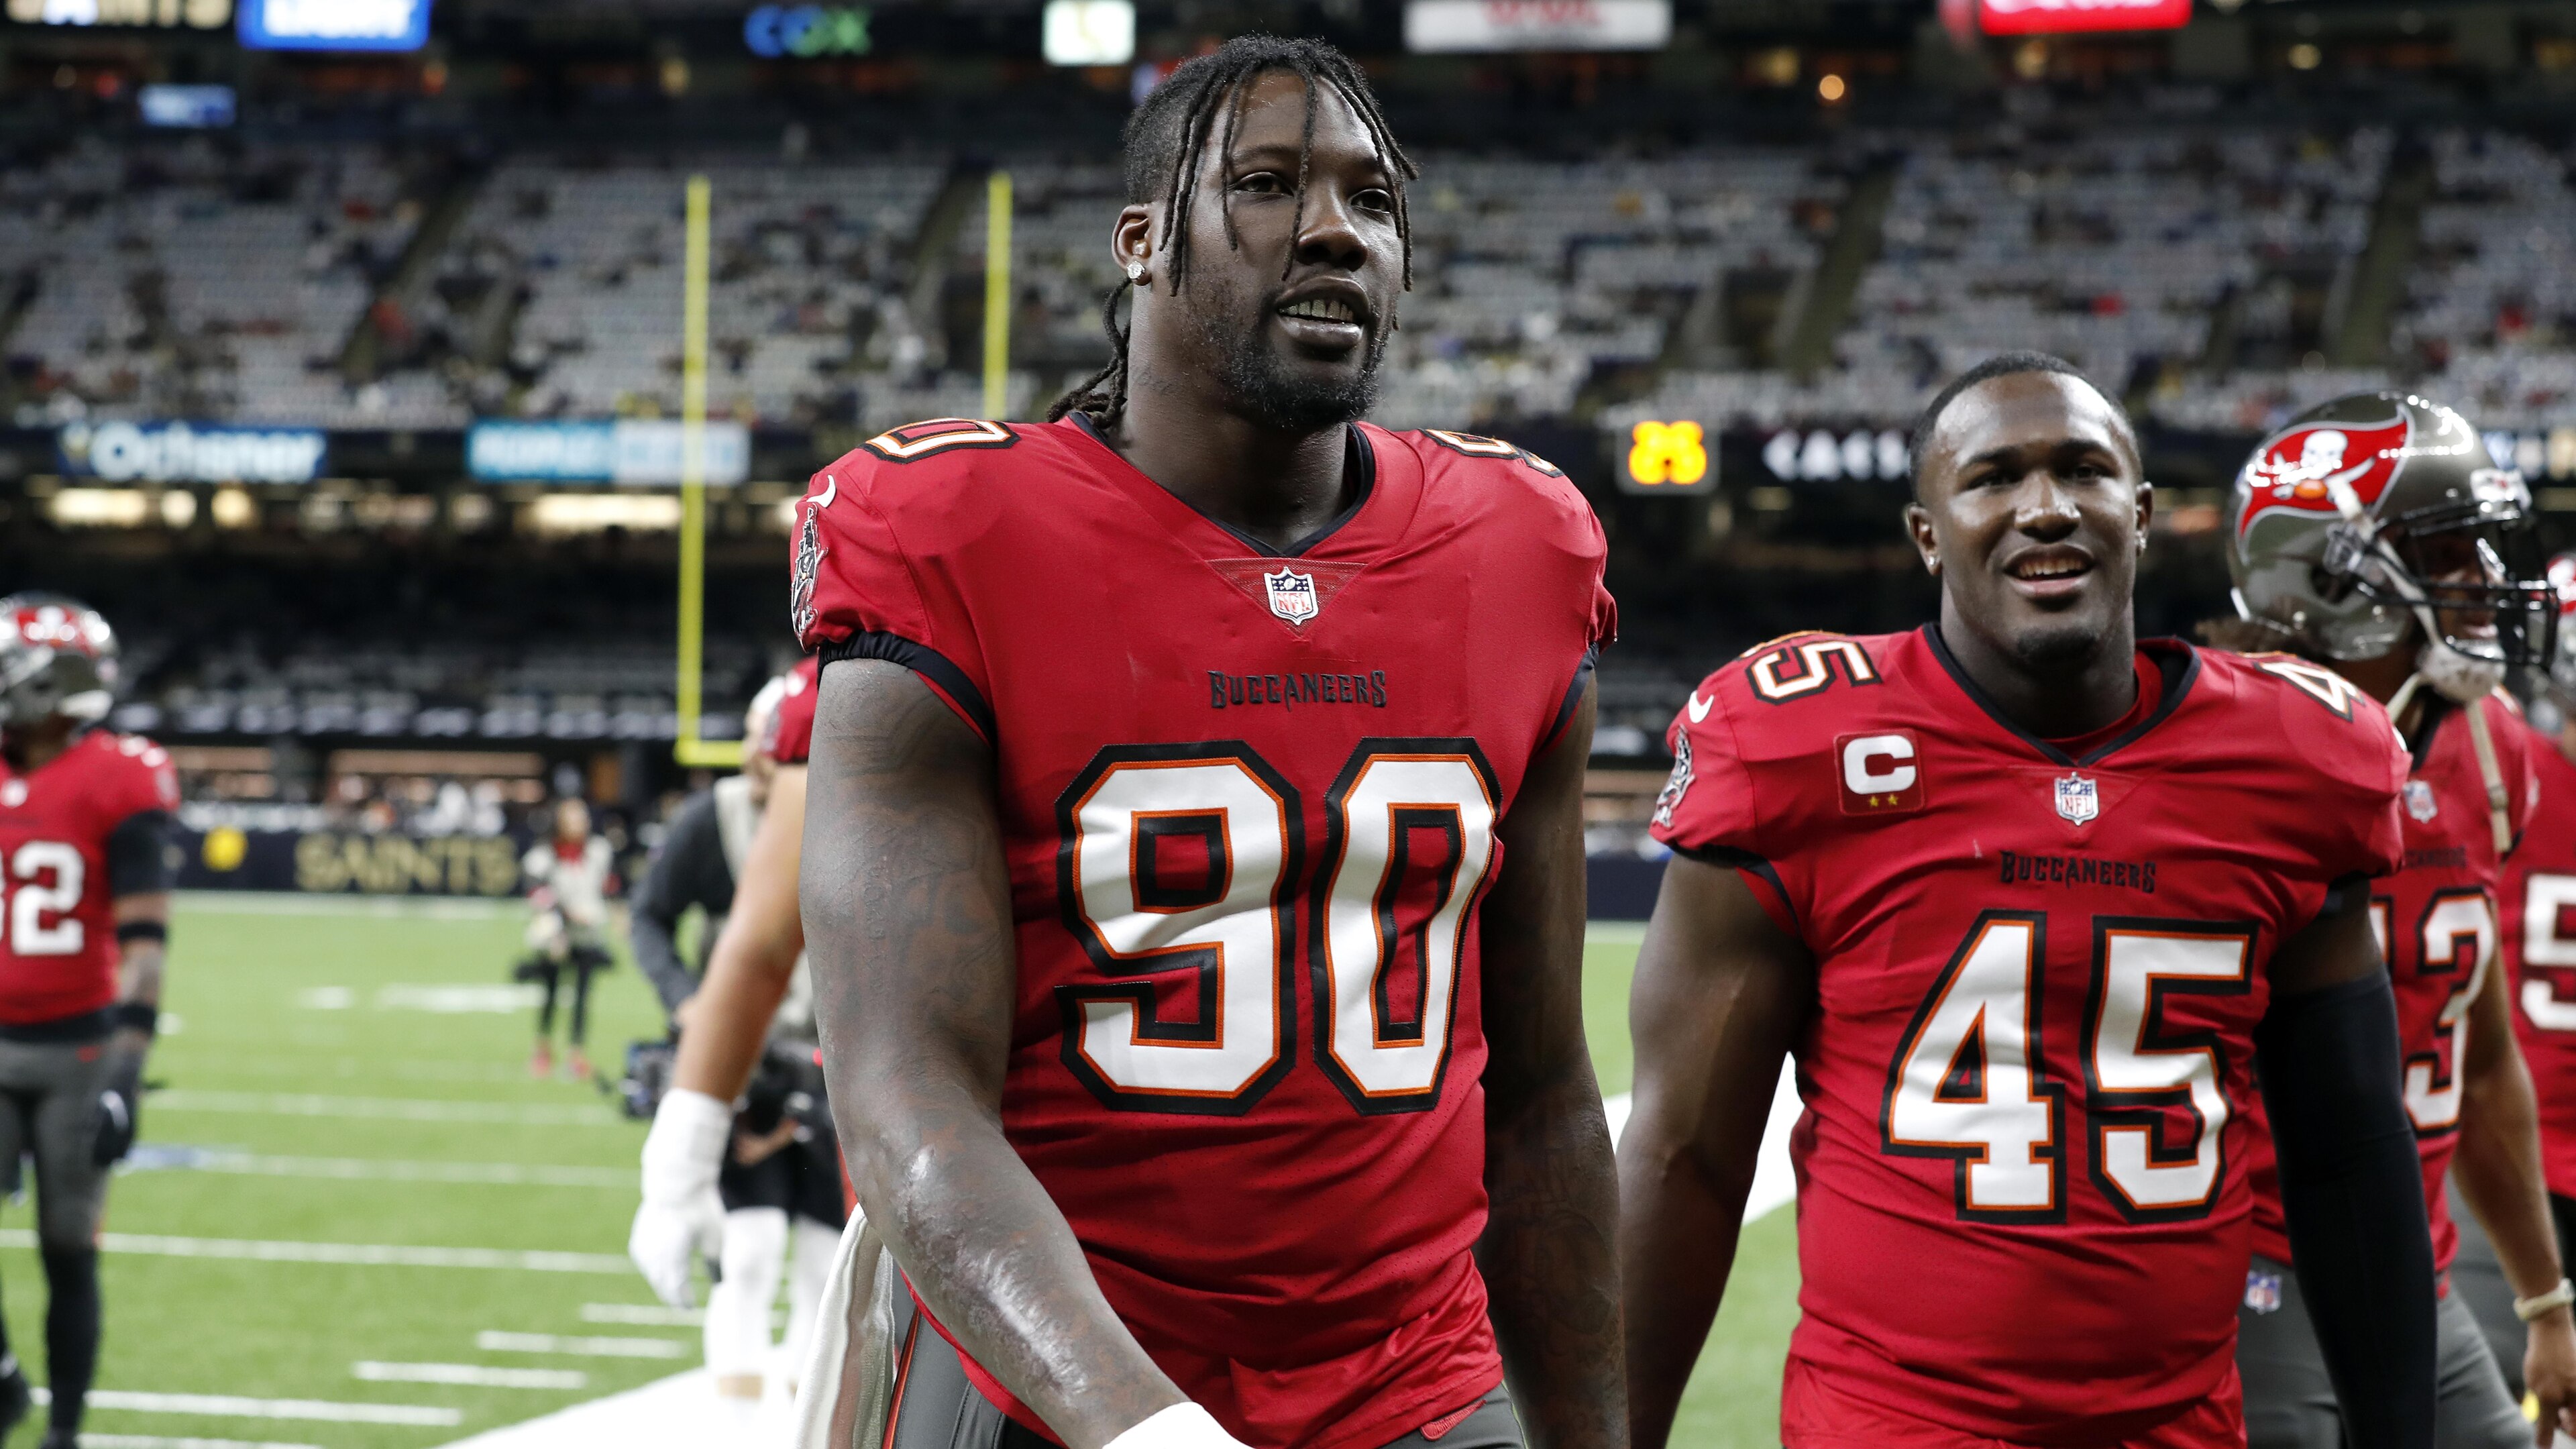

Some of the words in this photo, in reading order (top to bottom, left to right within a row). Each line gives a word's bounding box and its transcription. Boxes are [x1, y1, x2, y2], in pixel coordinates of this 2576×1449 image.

[1276, 592, 1311, 614] NFL
[1208, 669, 1387, 712] BUCCANEERS
[1843, 734, 1917, 795] C
[0, 839, 85, 957] 2
[1999, 850, 2156, 894] BUCCANEERS
[1055, 737, 1503, 1116] 90
[1880, 908, 2259, 1225] 45
